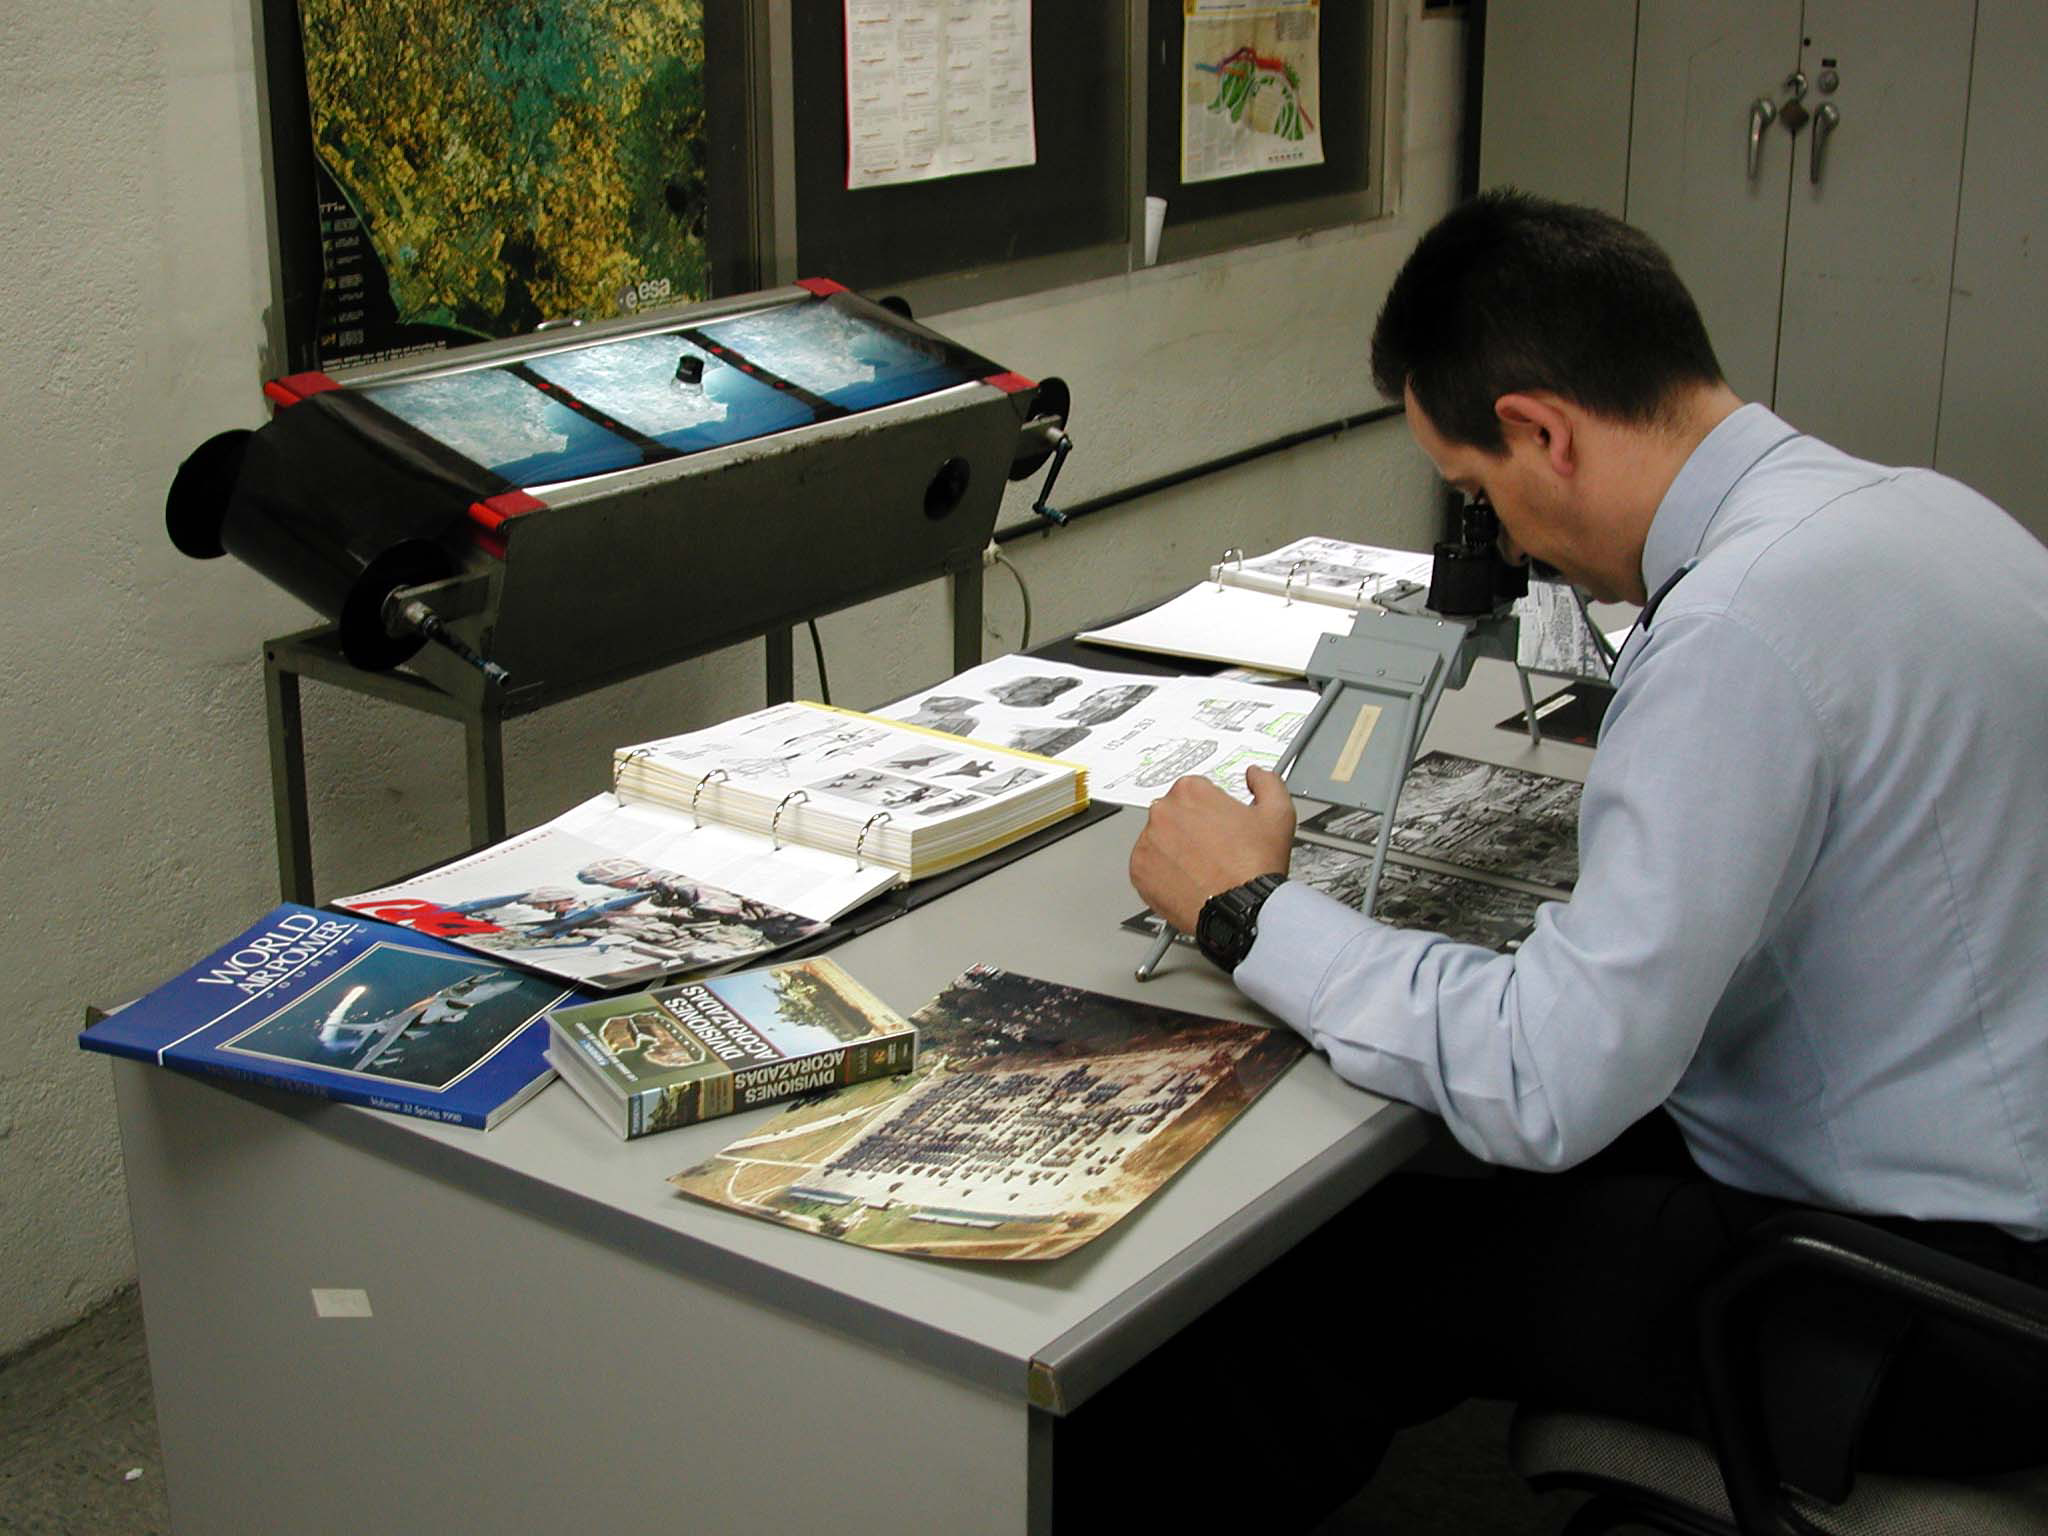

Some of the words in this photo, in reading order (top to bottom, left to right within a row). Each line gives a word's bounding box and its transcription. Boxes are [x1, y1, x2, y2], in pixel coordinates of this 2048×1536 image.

[638, 278, 670, 300] esa
[197, 913, 318, 984] WORLD
[266, 927, 368, 999] JOURNAL
[664, 998, 745, 1061] DIVISIONES
[682, 985, 779, 1060] ACORAZADAS
[734, 1049, 846, 1090] ACORAZADAS
[745, 1068, 835, 1103] DIVISIONES
